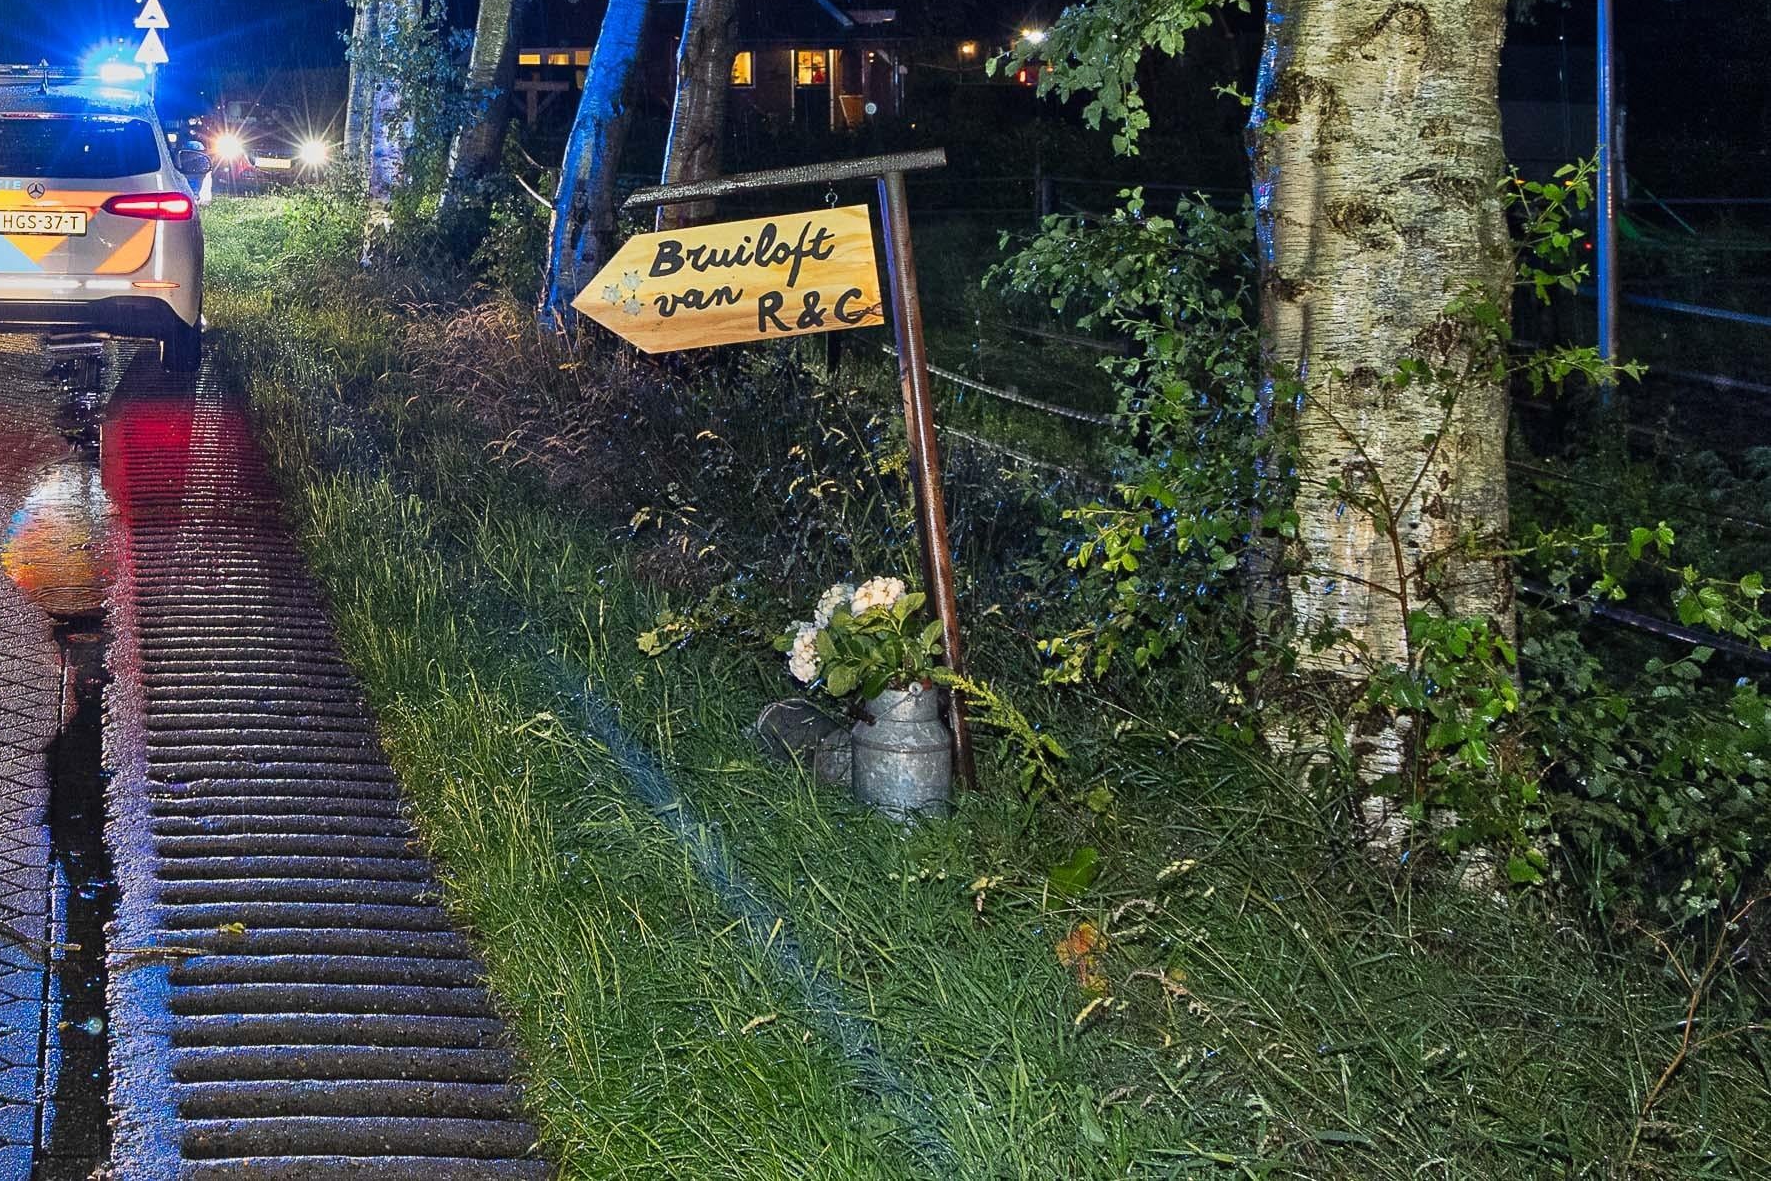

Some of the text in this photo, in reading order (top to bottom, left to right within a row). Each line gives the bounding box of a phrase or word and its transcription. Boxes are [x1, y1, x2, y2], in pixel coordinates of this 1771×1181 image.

[3, 215, 79, 230] HGS-37-T
[648, 221, 835, 287] Bruiloft
[654, 285, 743, 318] van
